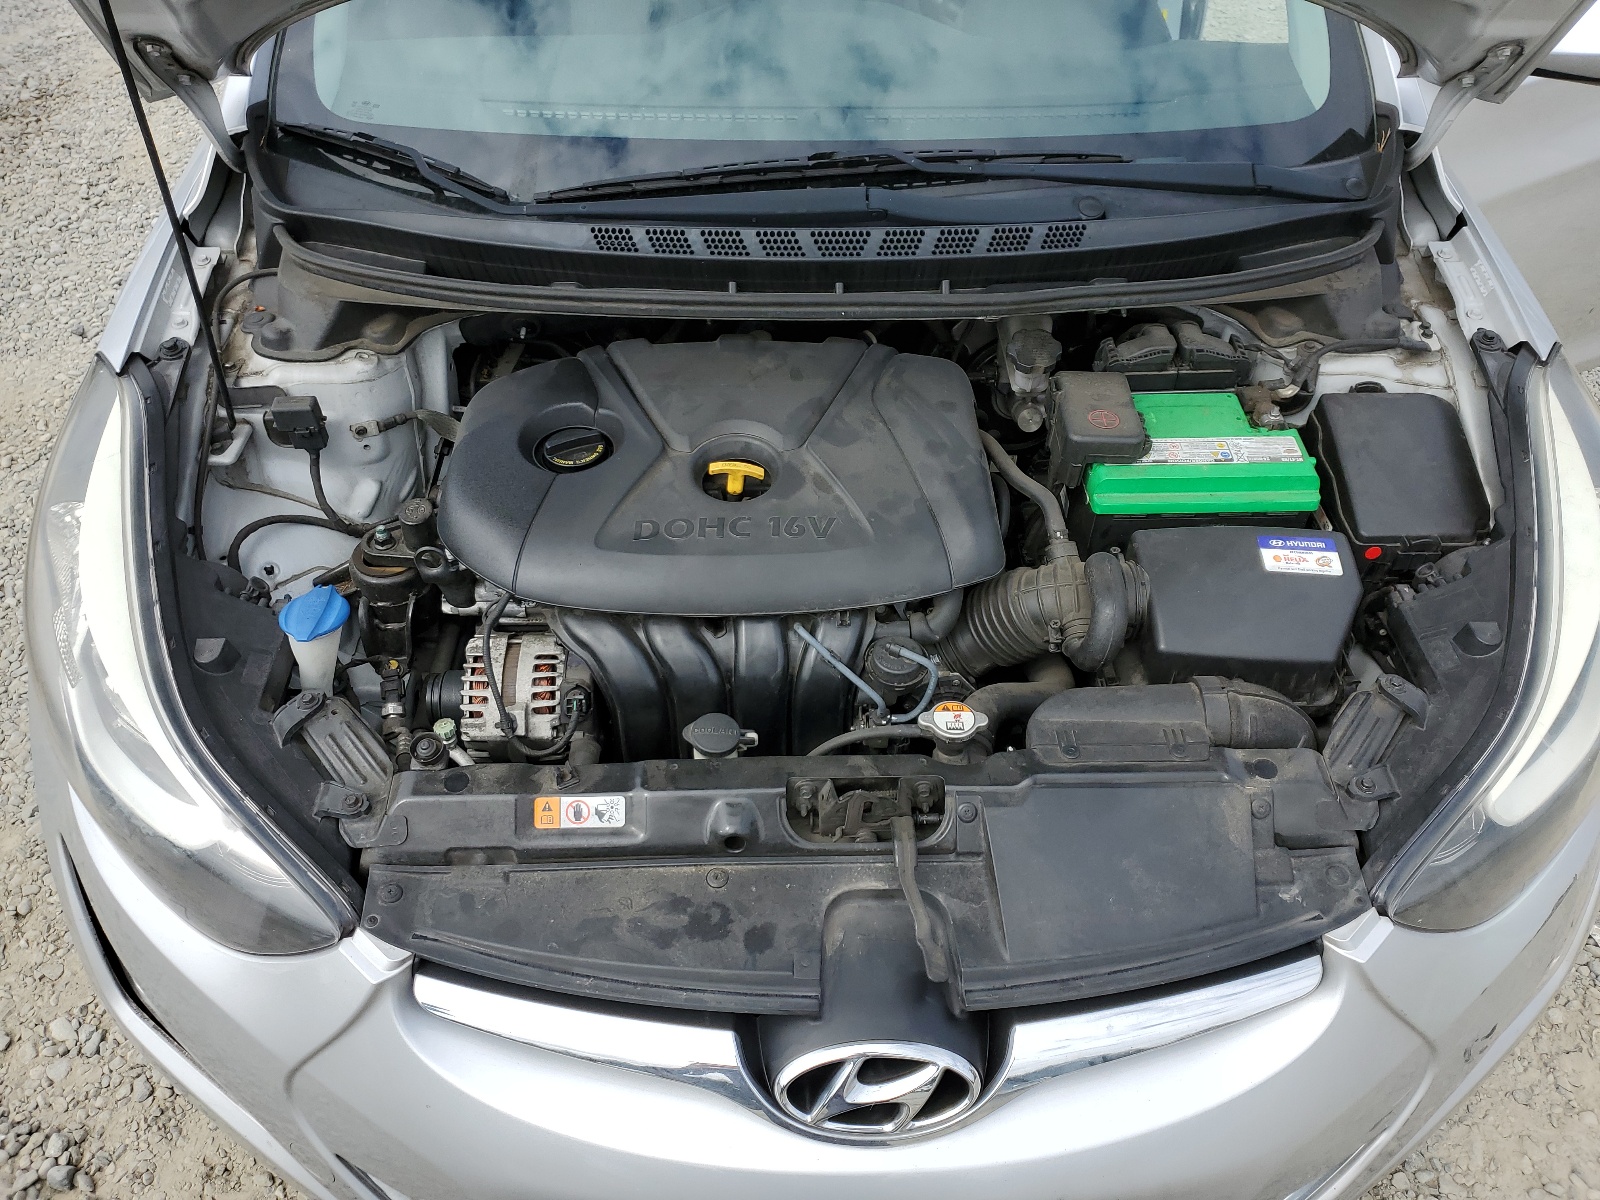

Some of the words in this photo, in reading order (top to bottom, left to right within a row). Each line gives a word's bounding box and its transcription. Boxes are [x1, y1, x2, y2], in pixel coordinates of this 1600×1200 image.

[632, 516, 752, 541] DOHC
[768, 516, 837, 539] 16V
[1286, 540, 1326, 549] HYUNDAI
